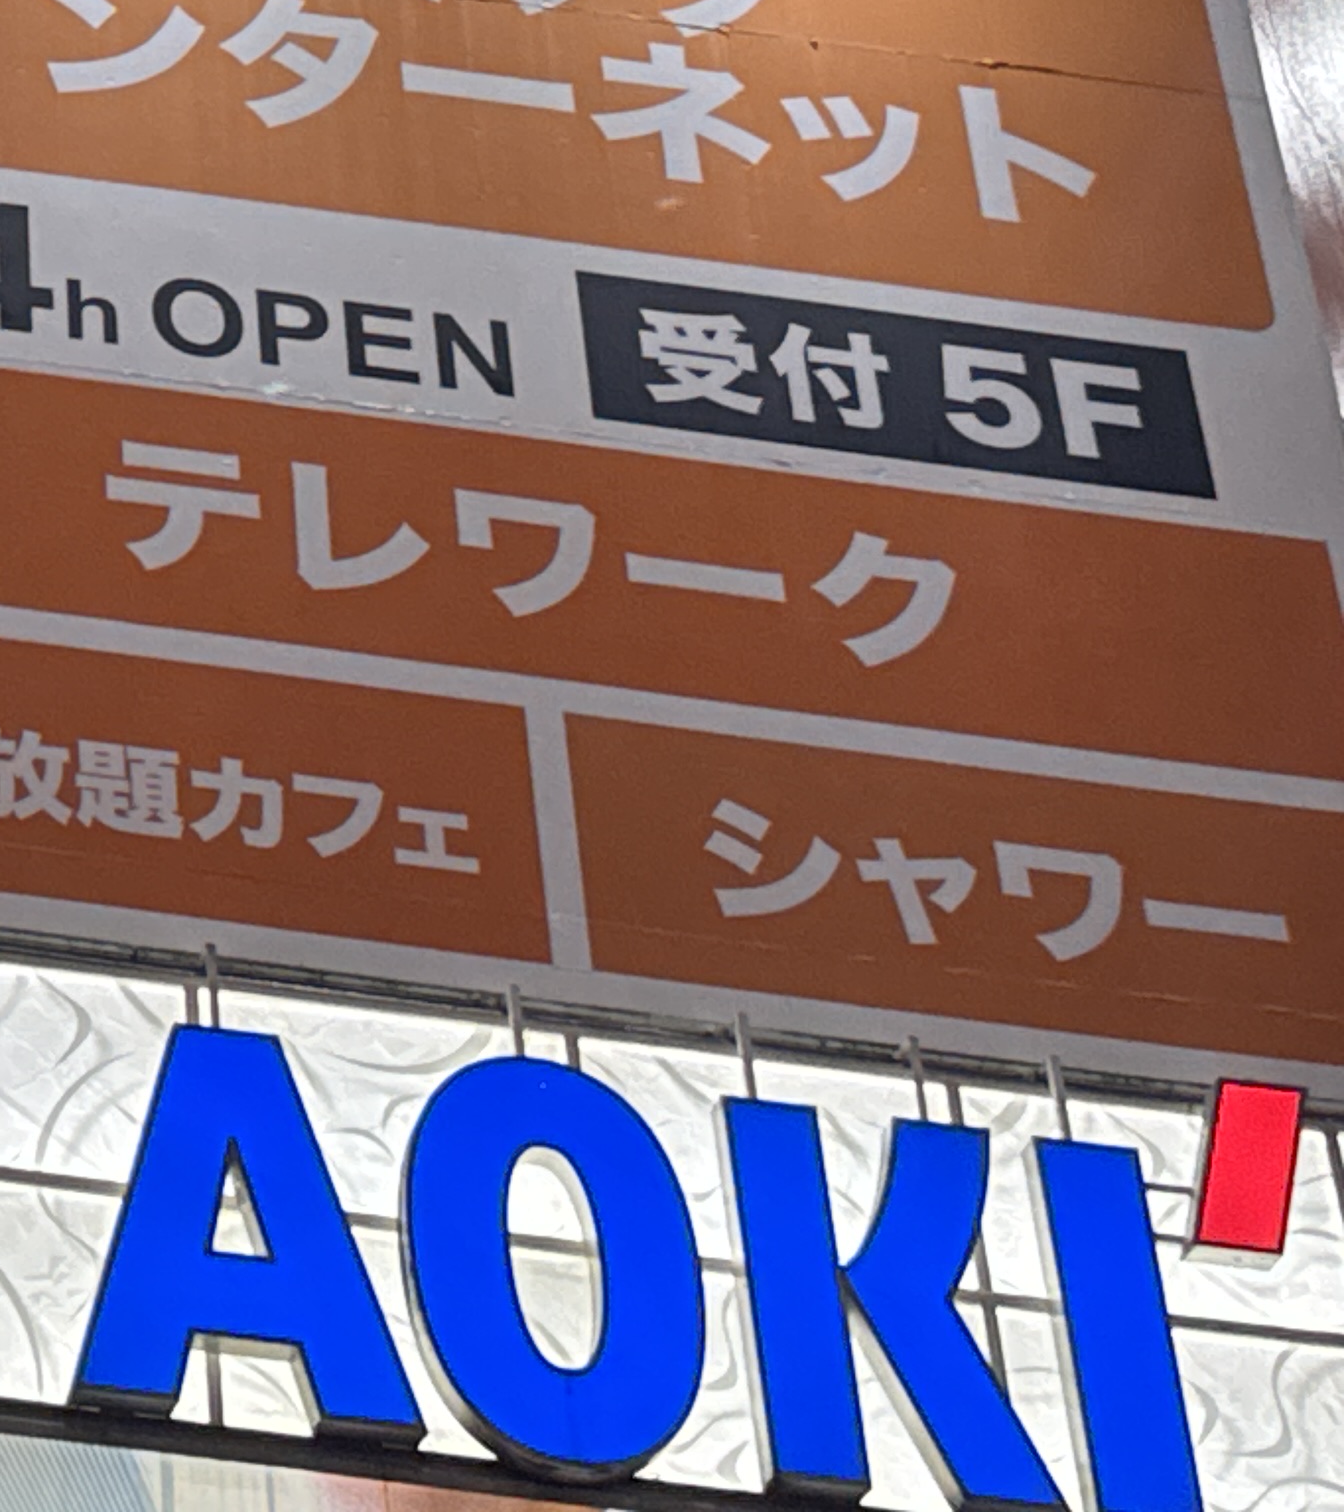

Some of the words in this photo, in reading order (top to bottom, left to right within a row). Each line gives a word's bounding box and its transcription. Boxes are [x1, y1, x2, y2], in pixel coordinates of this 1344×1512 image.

[151, 277, 517, 398] OPEN
[637, 307, 889, 430] 受付
[941, 342, 1146, 460] 5F
[103, 439, 959, 669] テレワーク
[702, 798, 1291, 962] シャワー
